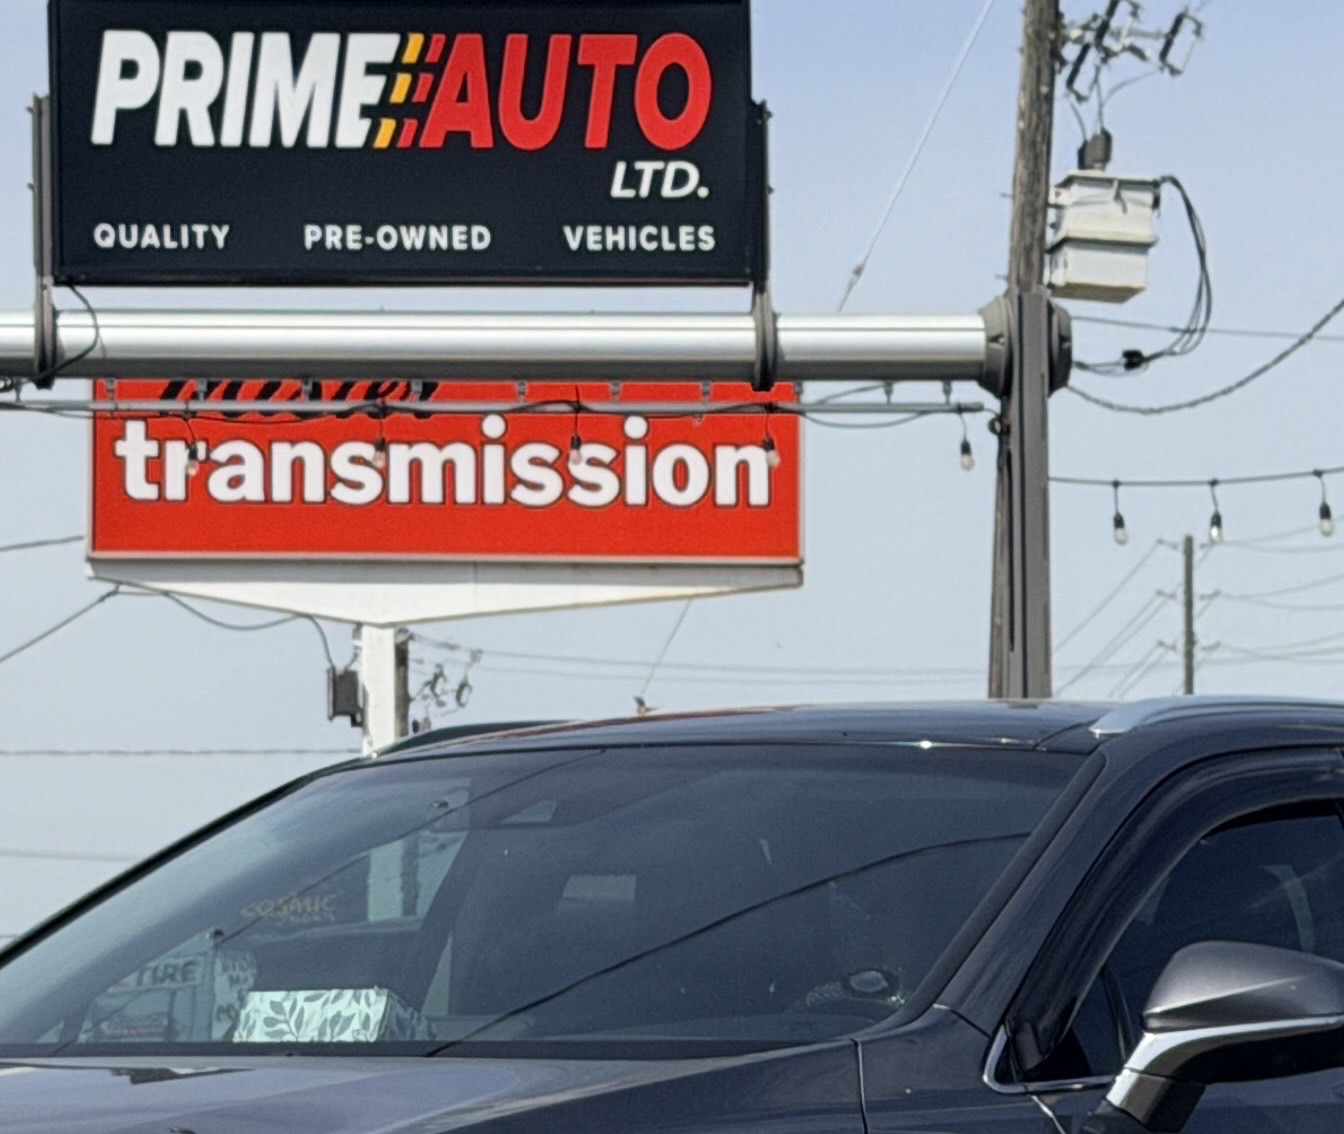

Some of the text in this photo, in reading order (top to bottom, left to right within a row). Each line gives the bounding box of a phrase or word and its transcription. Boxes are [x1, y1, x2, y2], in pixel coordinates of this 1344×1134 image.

[91, 30, 712, 150] PRIME AUTO
[610, 161, 709, 198] LTD.
[93, 223, 716, 251] QUALITY PRE-OWNED VEHICLES
[115, 413, 770, 507] transmission
